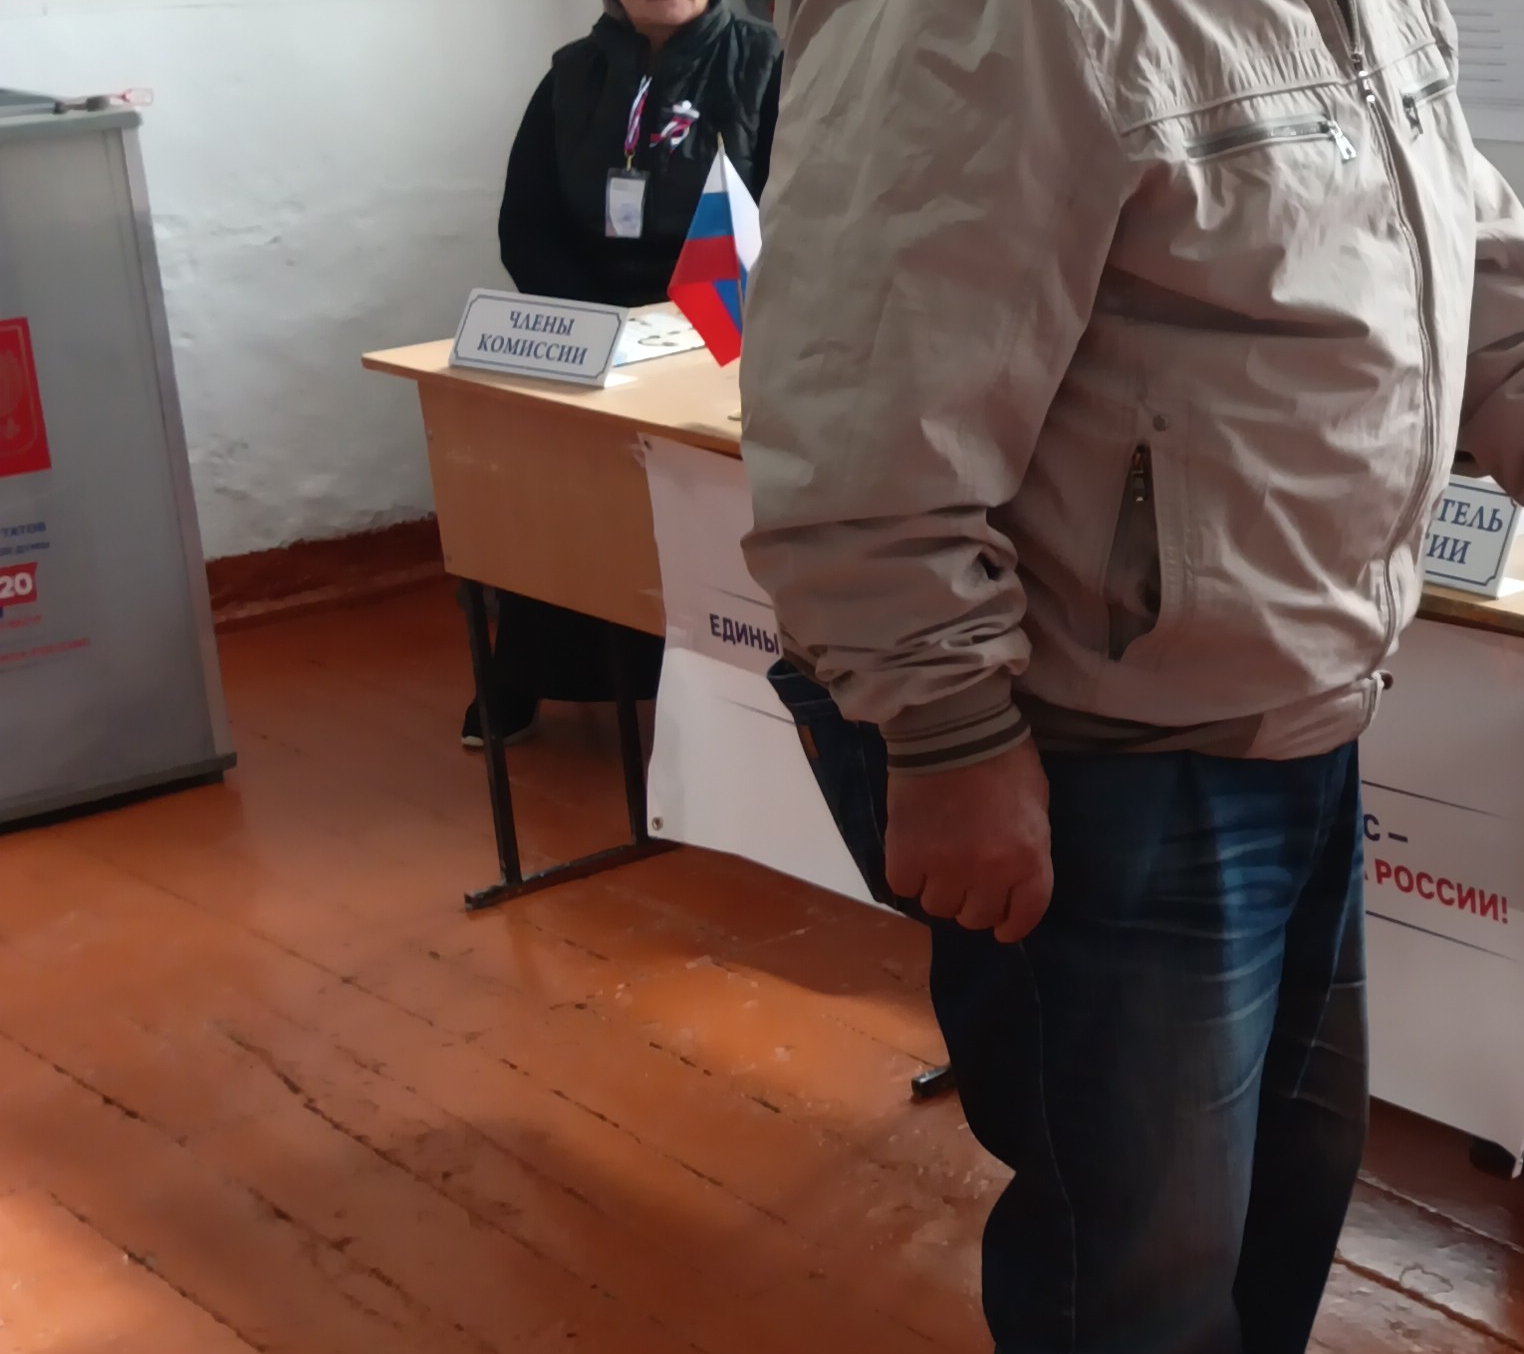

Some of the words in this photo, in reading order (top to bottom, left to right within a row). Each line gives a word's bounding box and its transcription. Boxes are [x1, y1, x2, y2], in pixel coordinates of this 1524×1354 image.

[509, 310, 575, 336] ЧЛЕНЫ
[477, 333, 588, 366] КОМИССИИ
[709, 613, 779, 656] ЕДИНЫ
[1374, 858, 1508, 924] РОССИИ!
